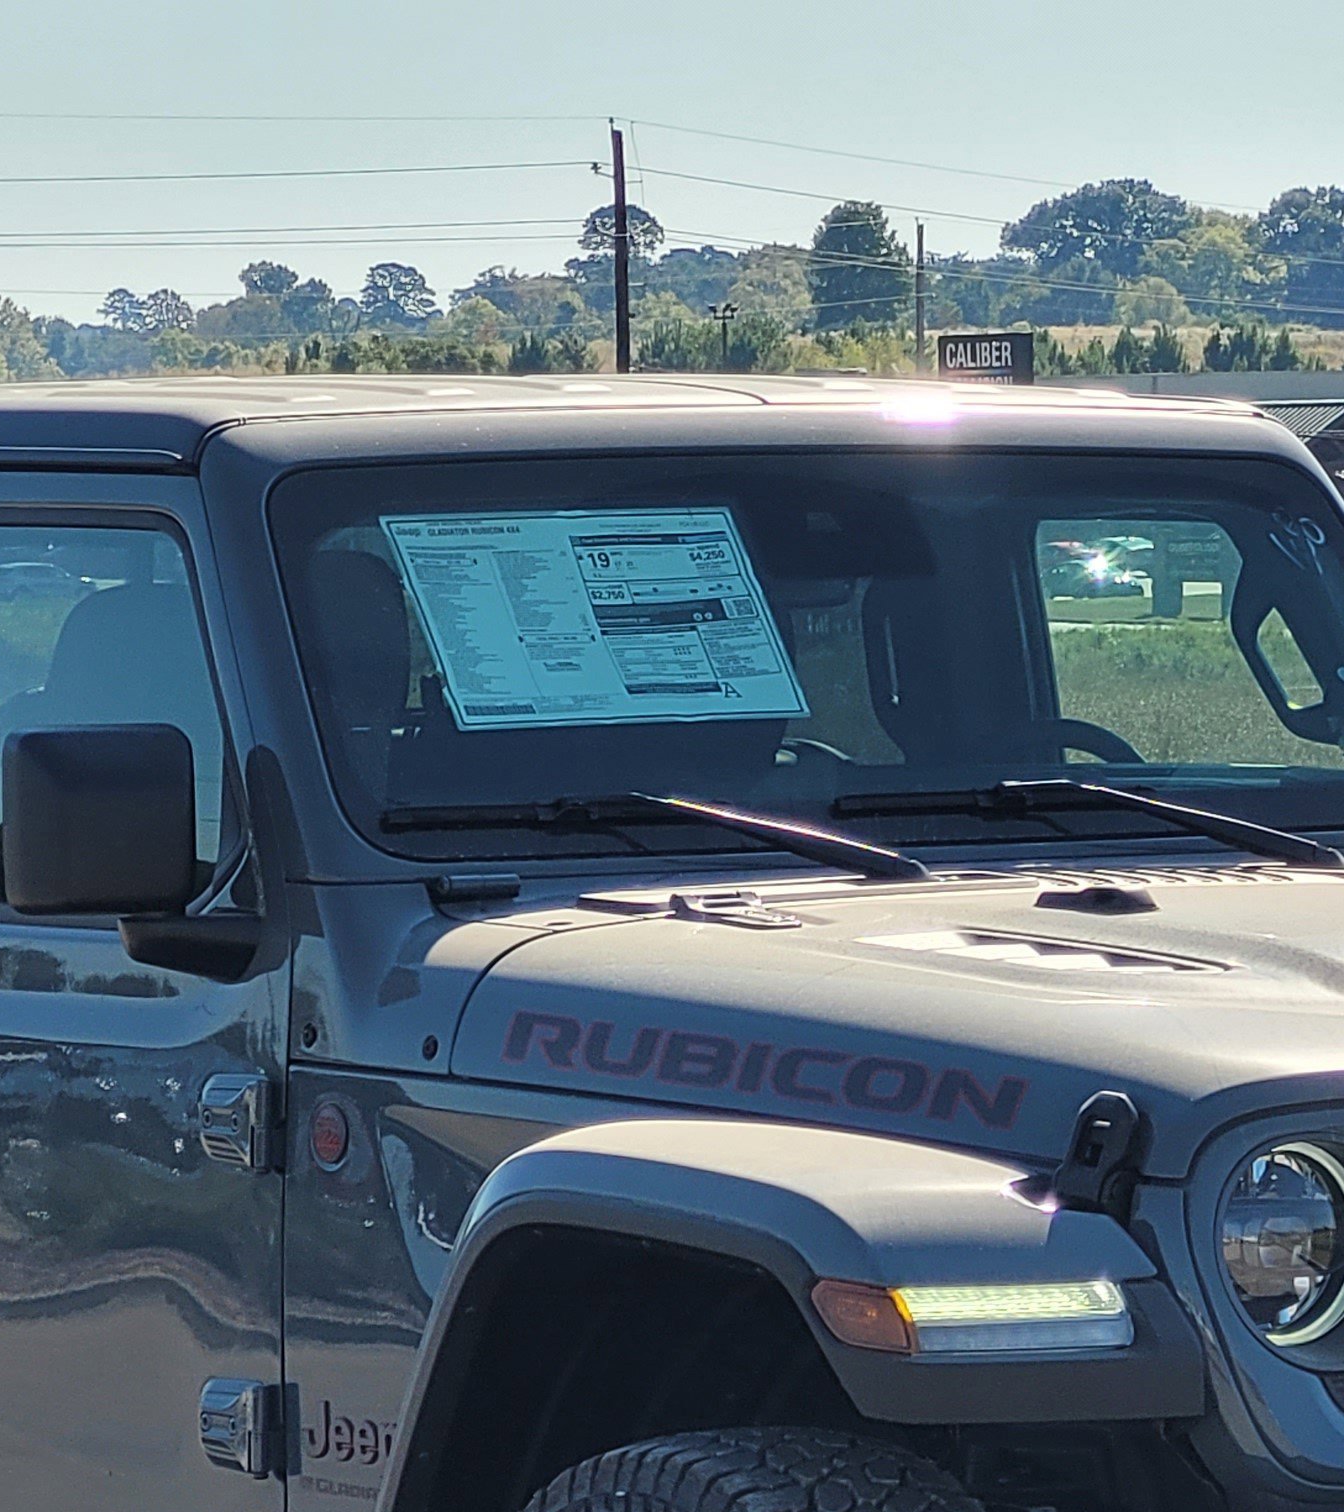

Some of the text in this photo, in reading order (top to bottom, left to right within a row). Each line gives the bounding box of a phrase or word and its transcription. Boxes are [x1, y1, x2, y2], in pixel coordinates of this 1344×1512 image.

[946, 341, 1012, 368] CALIBER
[587, 552, 610, 568] 19
[689, 549, 725, 562] $4,250
[591, 591, 625, 600] $2,750
[721, 682, 742, 698] A
[501, 1011, 1029, 1130] RUBICON
